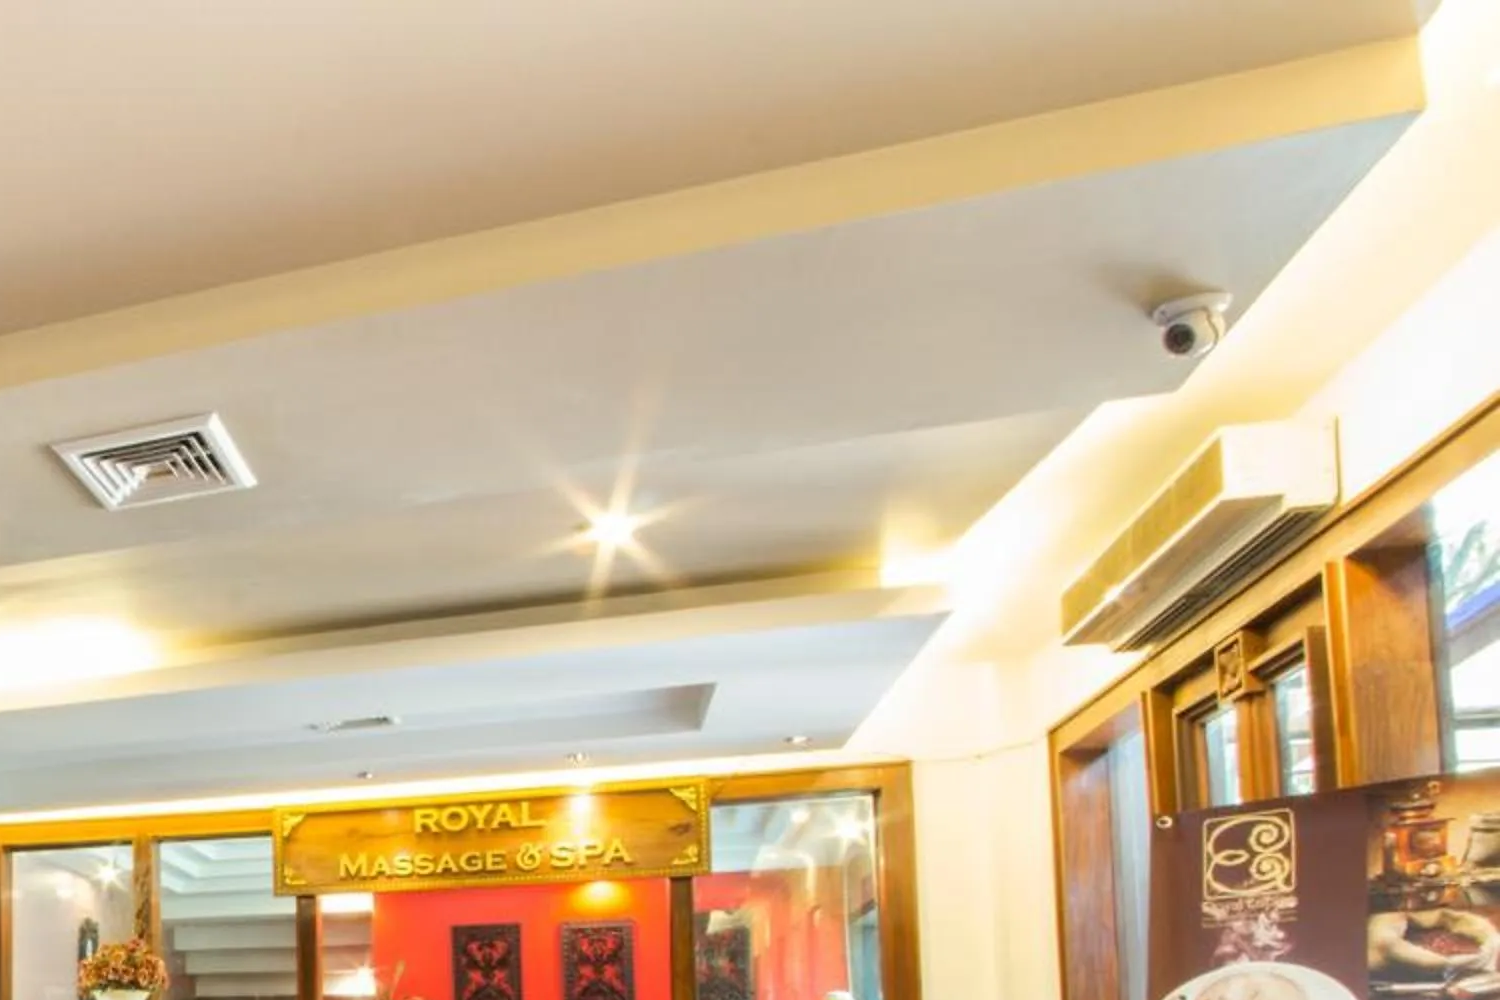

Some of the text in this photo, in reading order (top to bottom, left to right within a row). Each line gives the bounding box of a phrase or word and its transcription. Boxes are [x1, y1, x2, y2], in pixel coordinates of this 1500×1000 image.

[413, 801, 548, 834] ROYAL
[338, 838, 632, 881] MASSAGE & SPA
